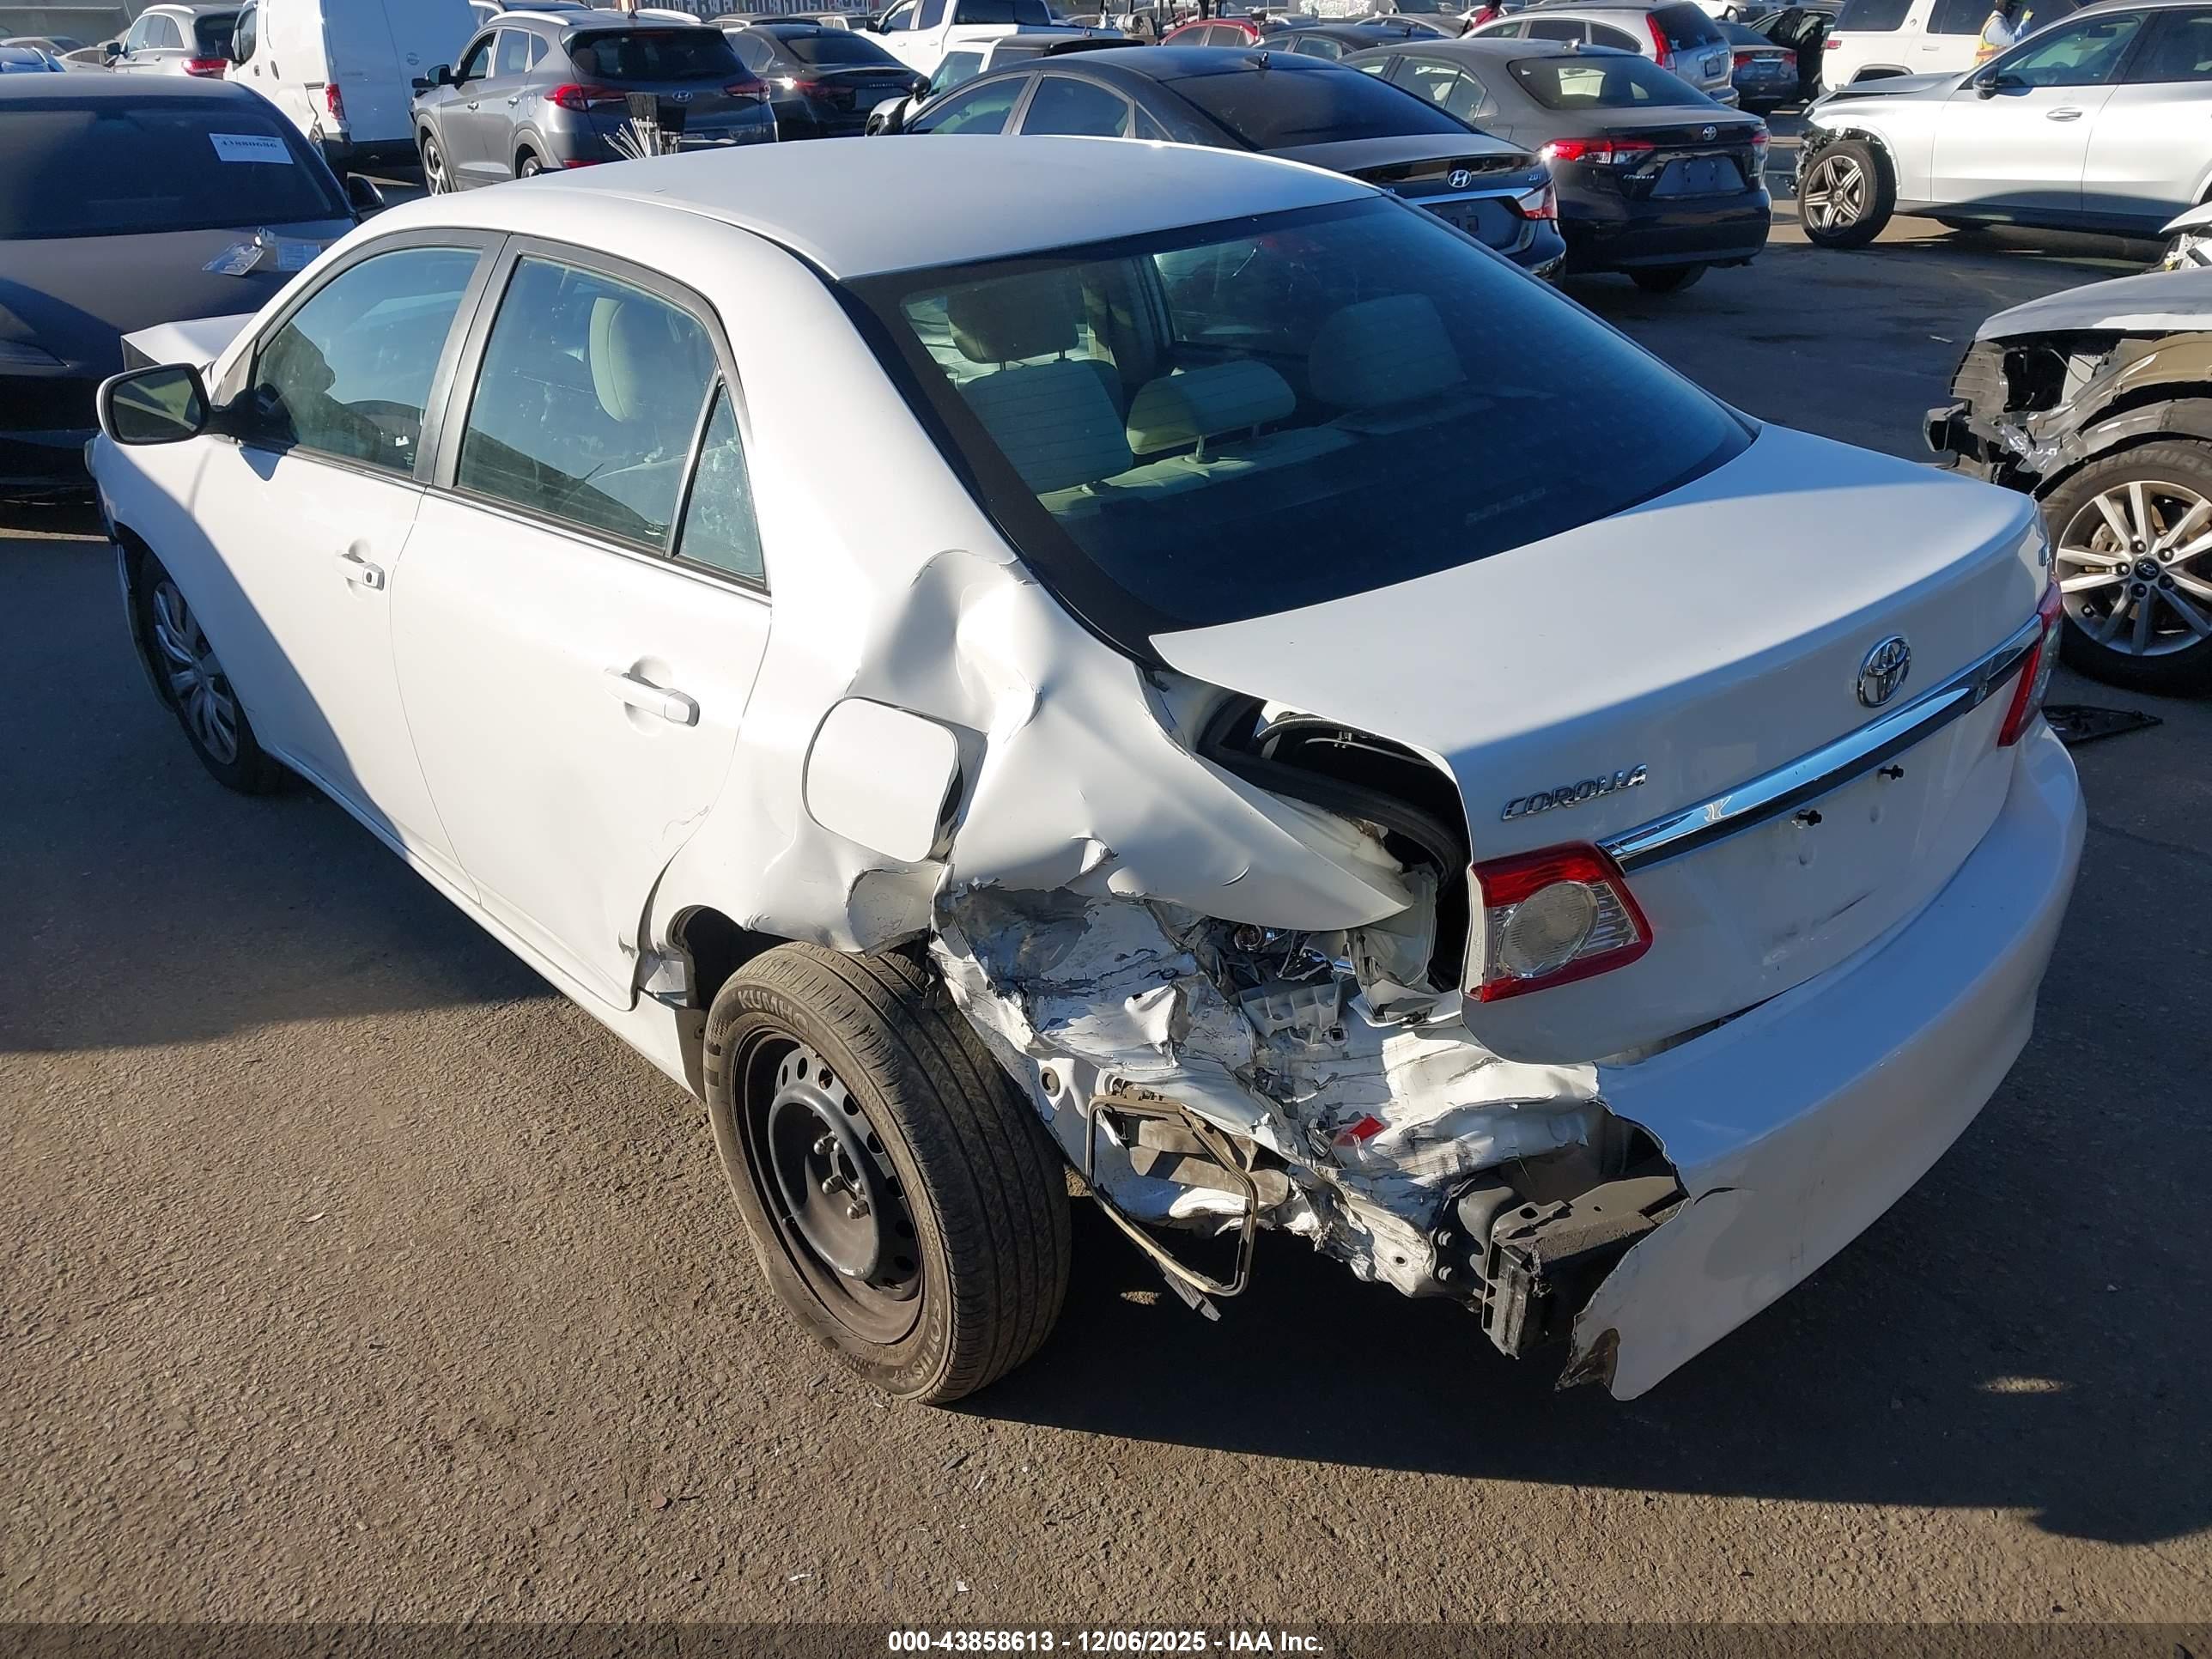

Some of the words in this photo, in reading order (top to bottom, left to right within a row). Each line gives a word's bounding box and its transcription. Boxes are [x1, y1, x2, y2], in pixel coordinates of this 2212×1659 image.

[1501, 763, 1647, 821] COROLLA
[737, 989, 809, 1036] KUMHO
[910, 1297, 942, 1381] SOLUS
